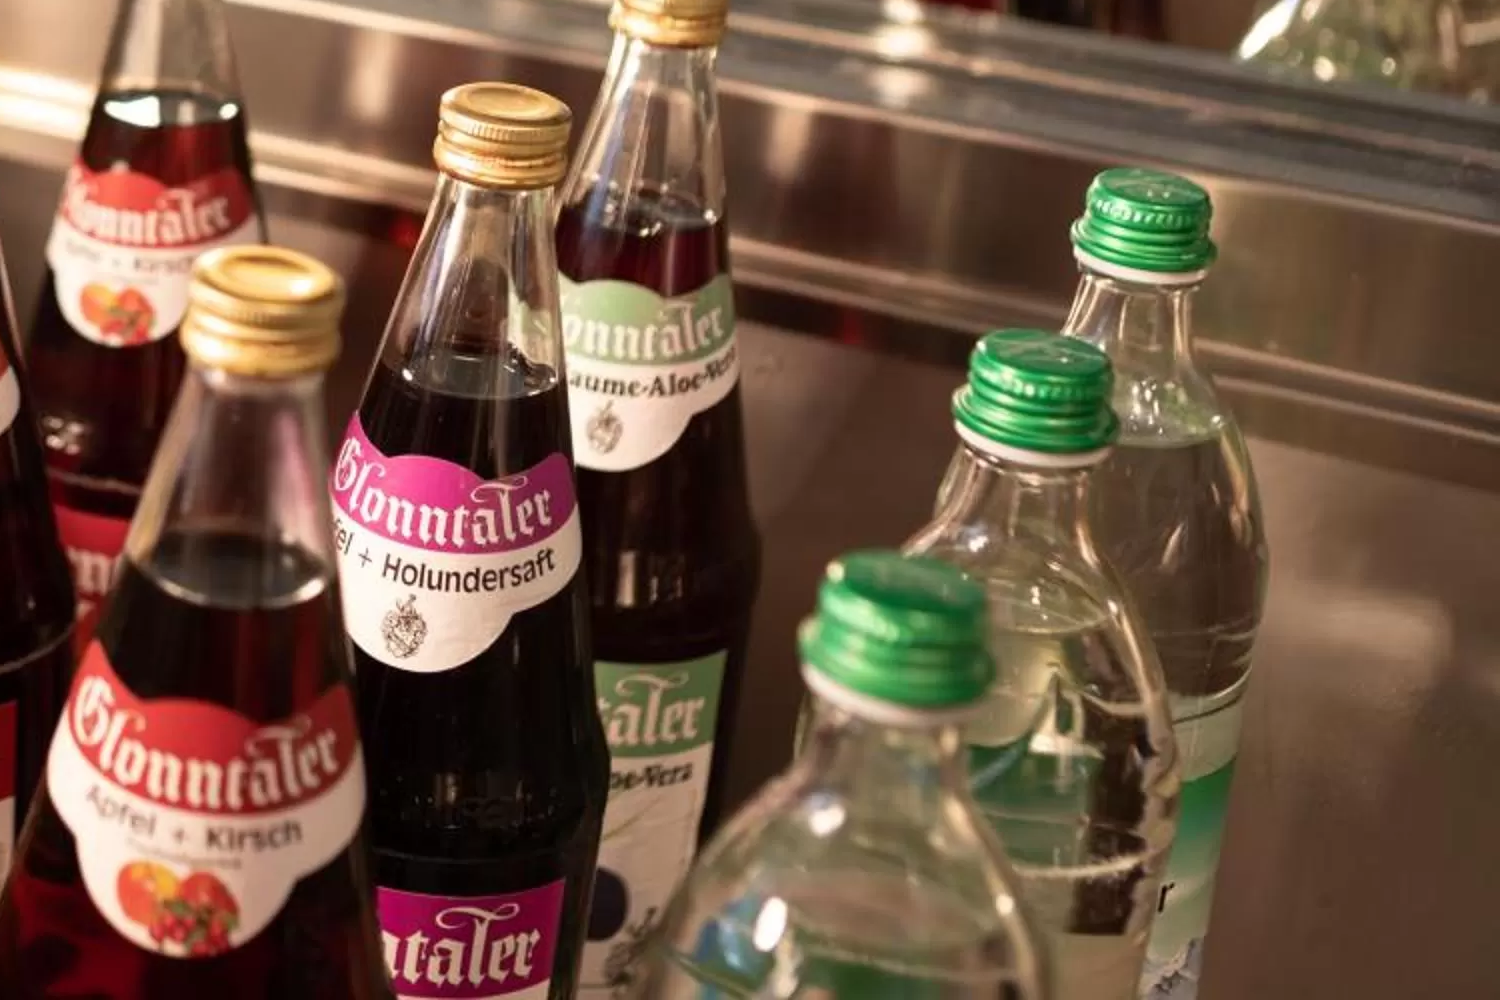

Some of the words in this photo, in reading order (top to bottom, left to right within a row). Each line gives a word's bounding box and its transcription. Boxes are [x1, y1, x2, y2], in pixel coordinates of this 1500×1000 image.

[334, 436, 553, 548] Glonntaler
[382, 547, 556, 594] Holundersaft
[73, 675, 339, 811] Glonntaler
[85, 783, 158, 836] Apfel
[205, 818, 304, 851] Kirsch
